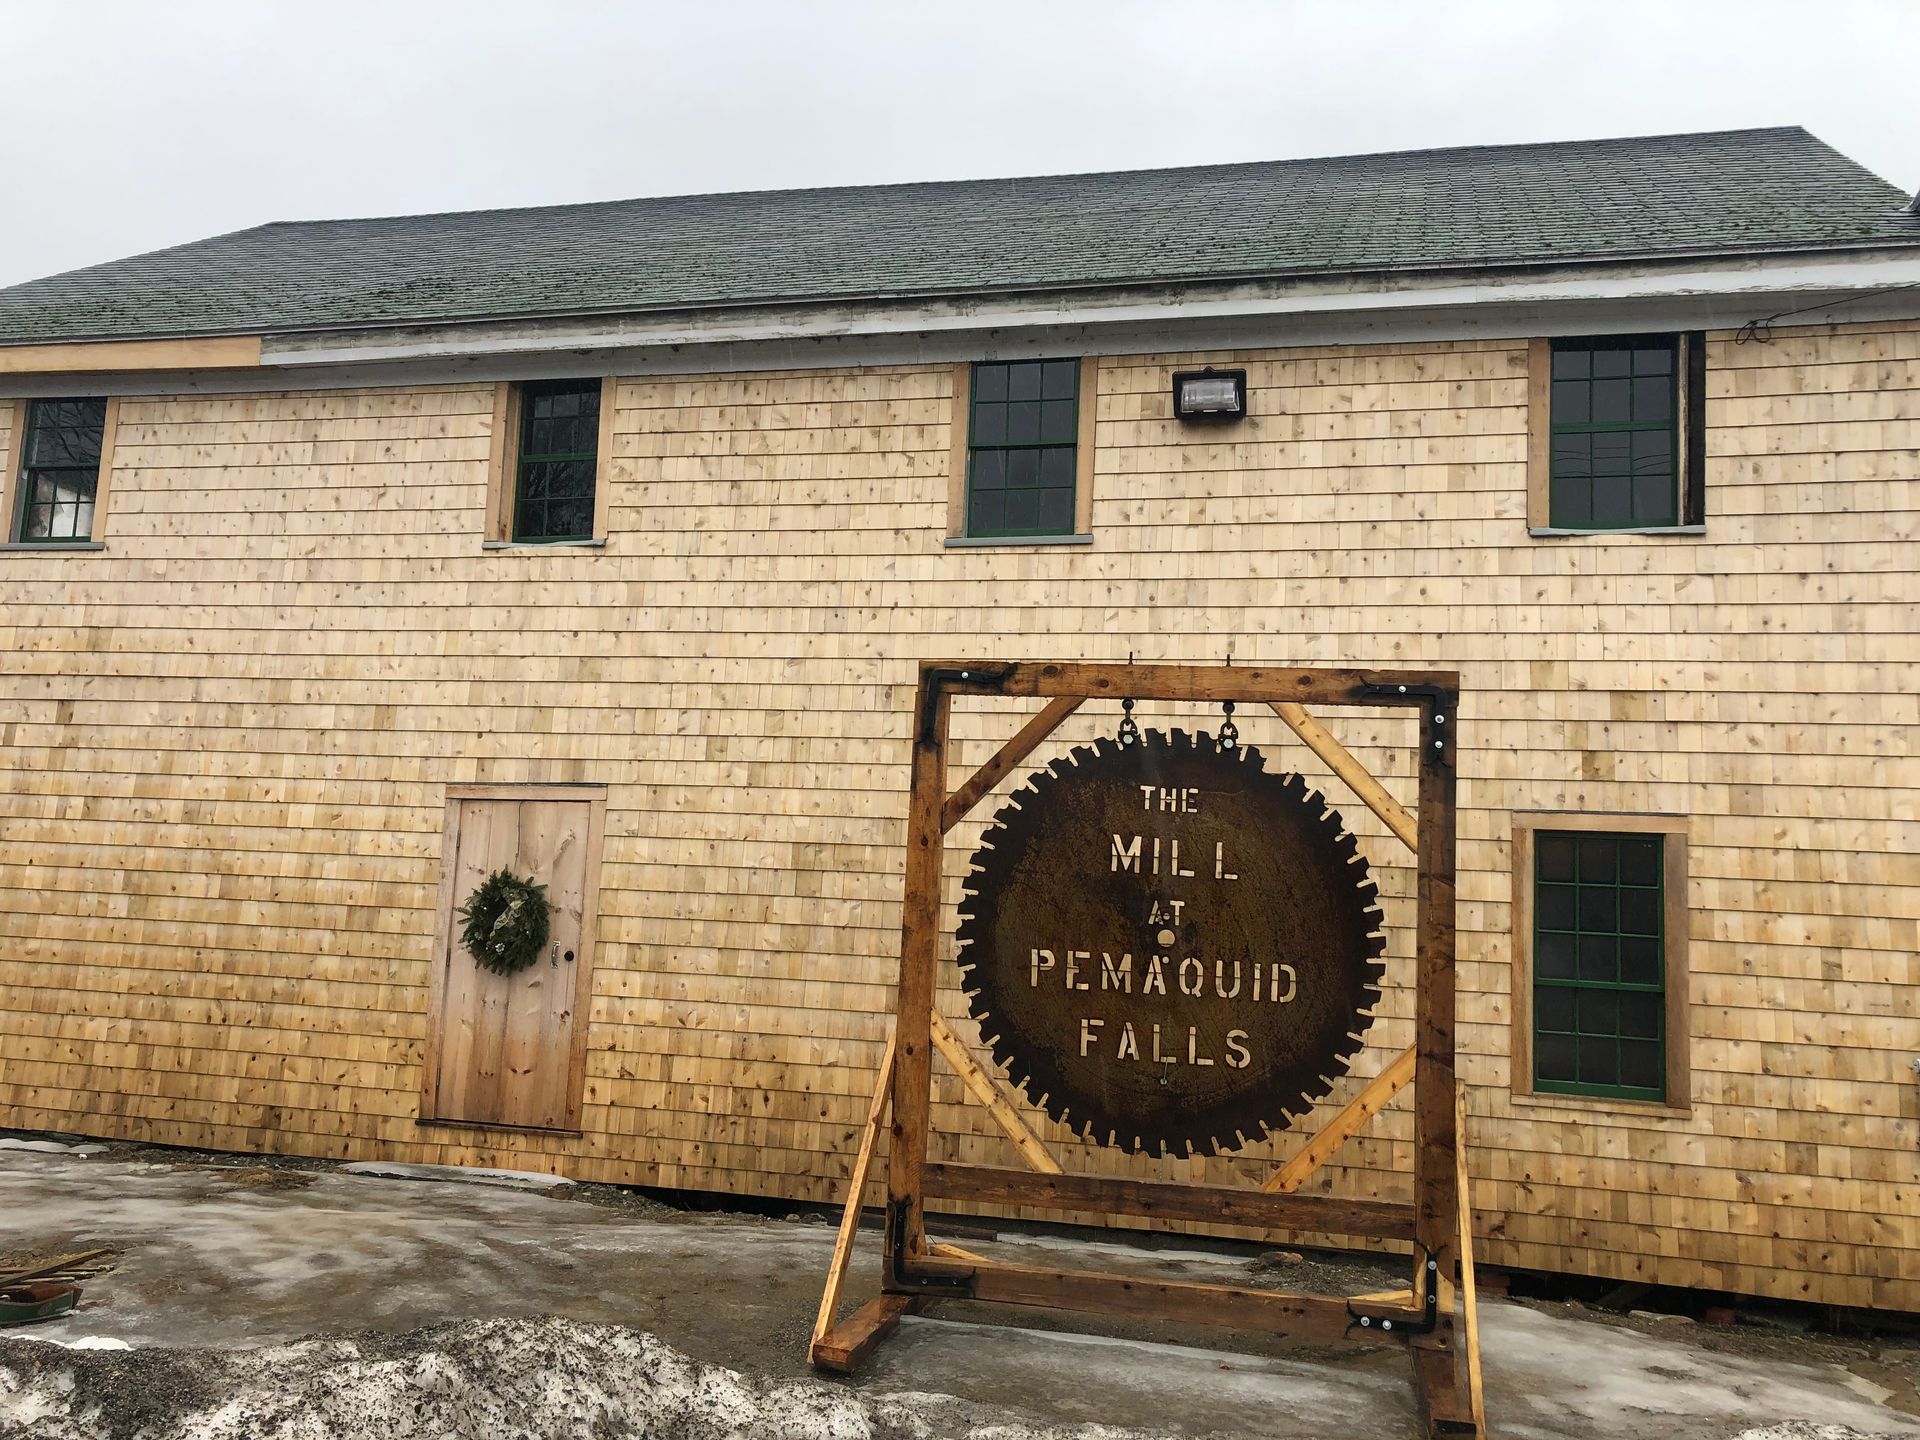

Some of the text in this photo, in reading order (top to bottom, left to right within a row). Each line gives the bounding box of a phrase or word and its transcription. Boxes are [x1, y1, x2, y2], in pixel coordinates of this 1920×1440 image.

[1140, 785, 1199, 813] THE
[1111, 834, 1238, 880] MILL
[1148, 900, 1185, 926] AT
[1030, 949, 1297, 1003] PEMAQUID
[1080, 1018, 1251, 1069] FALLS
